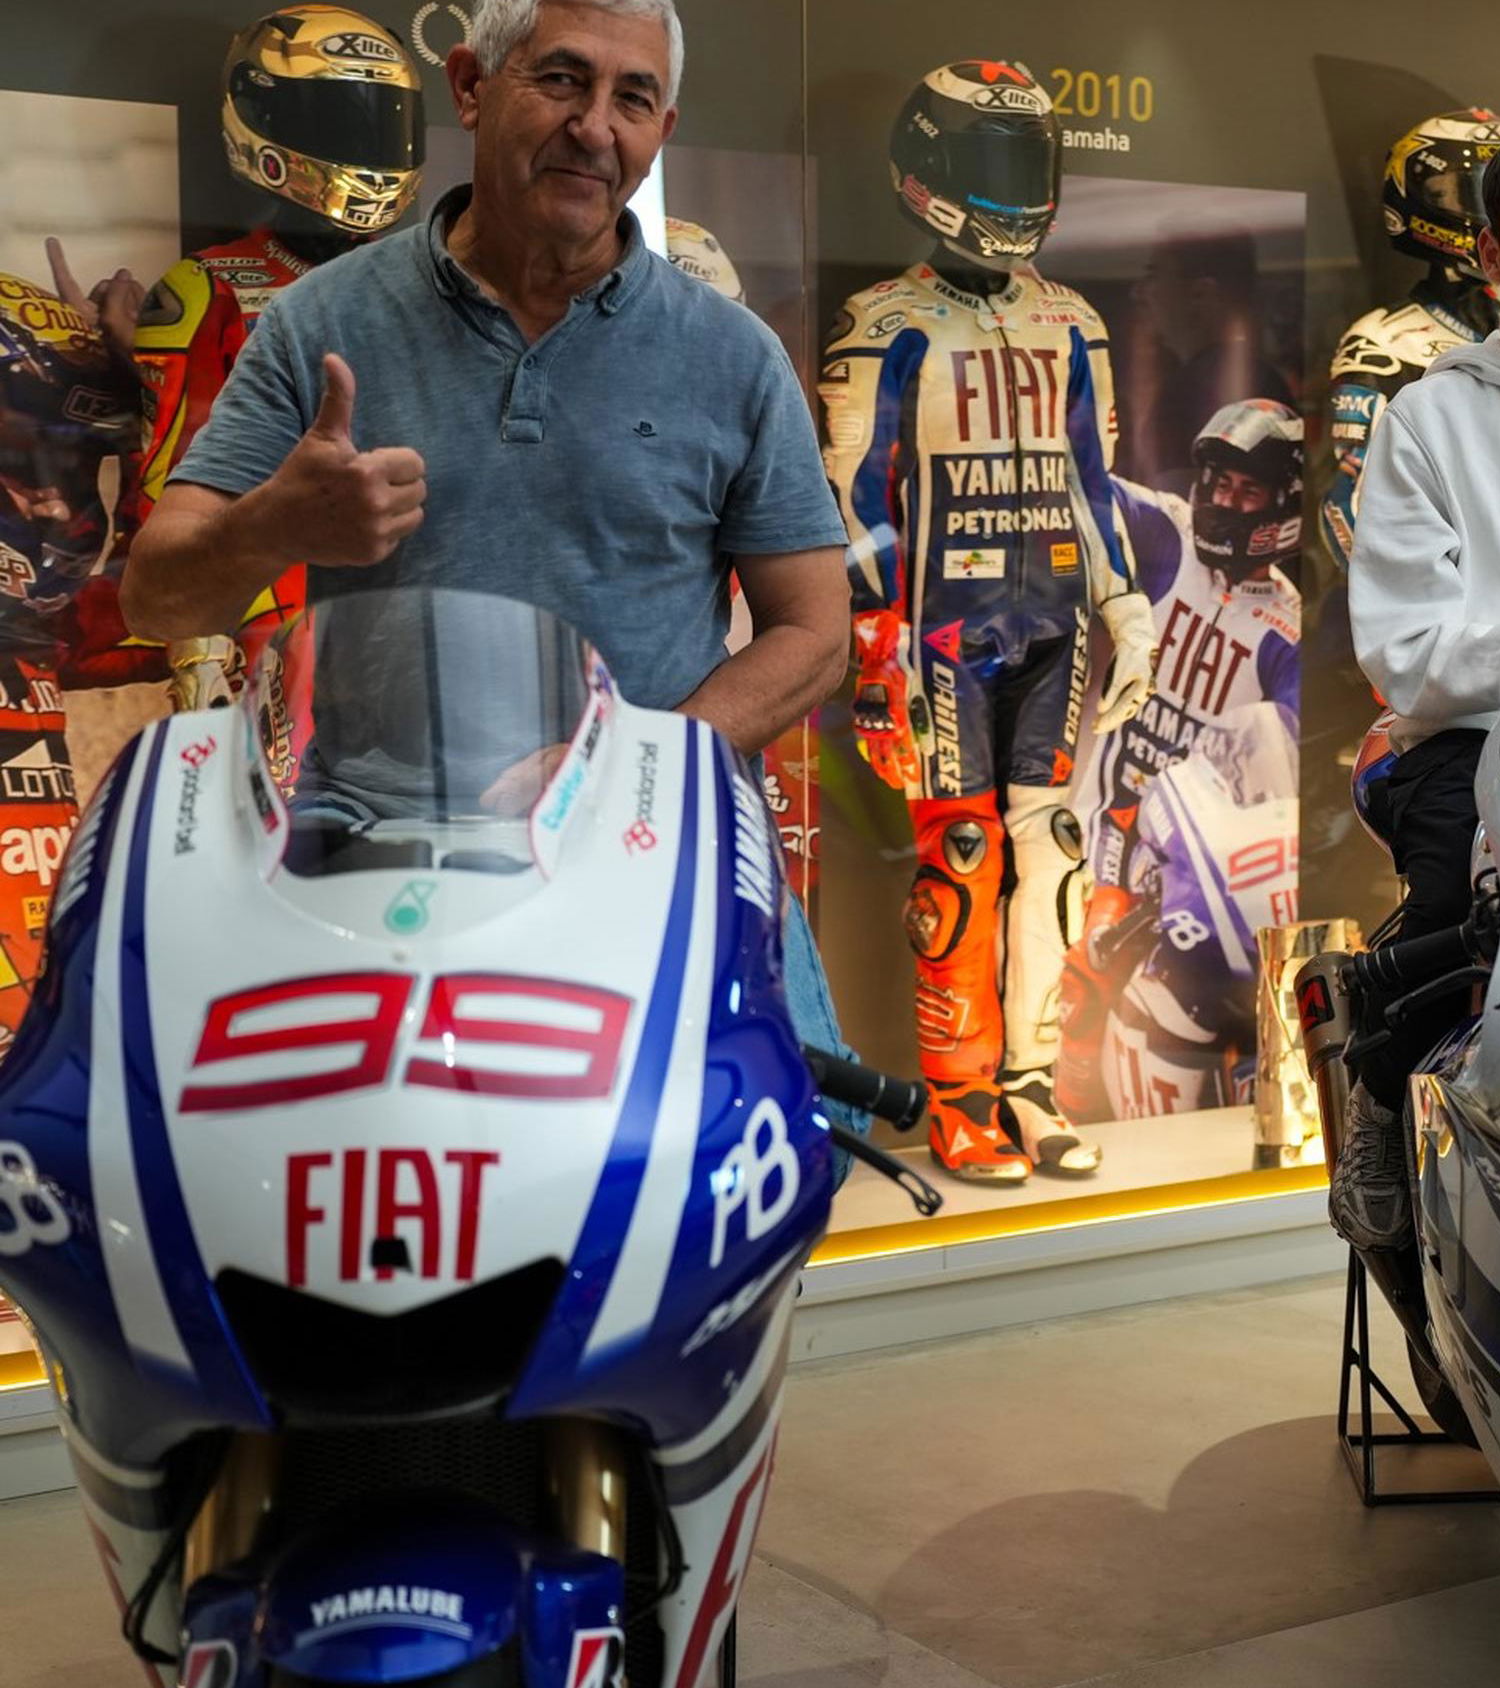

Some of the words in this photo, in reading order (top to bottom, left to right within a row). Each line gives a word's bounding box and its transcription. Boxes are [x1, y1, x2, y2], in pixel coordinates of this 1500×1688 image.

[1050, 68, 1153, 122] 2010
[1062, 128, 1130, 151] amaha
[933, 281, 980, 311] YAMAHA
[951, 348, 1058, 442] FIAT
[945, 456, 1067, 497] YAMAHA
[947, 508, 1073, 535] PETRONAS
[1154, 597, 1253, 717] FIAT
[1, 768, 76, 799] LOTU
[178, 971, 637, 1114] 99
[285, 1148, 500, 1289] FIAT
[310, 1585, 464, 1625] YAMALUBE
